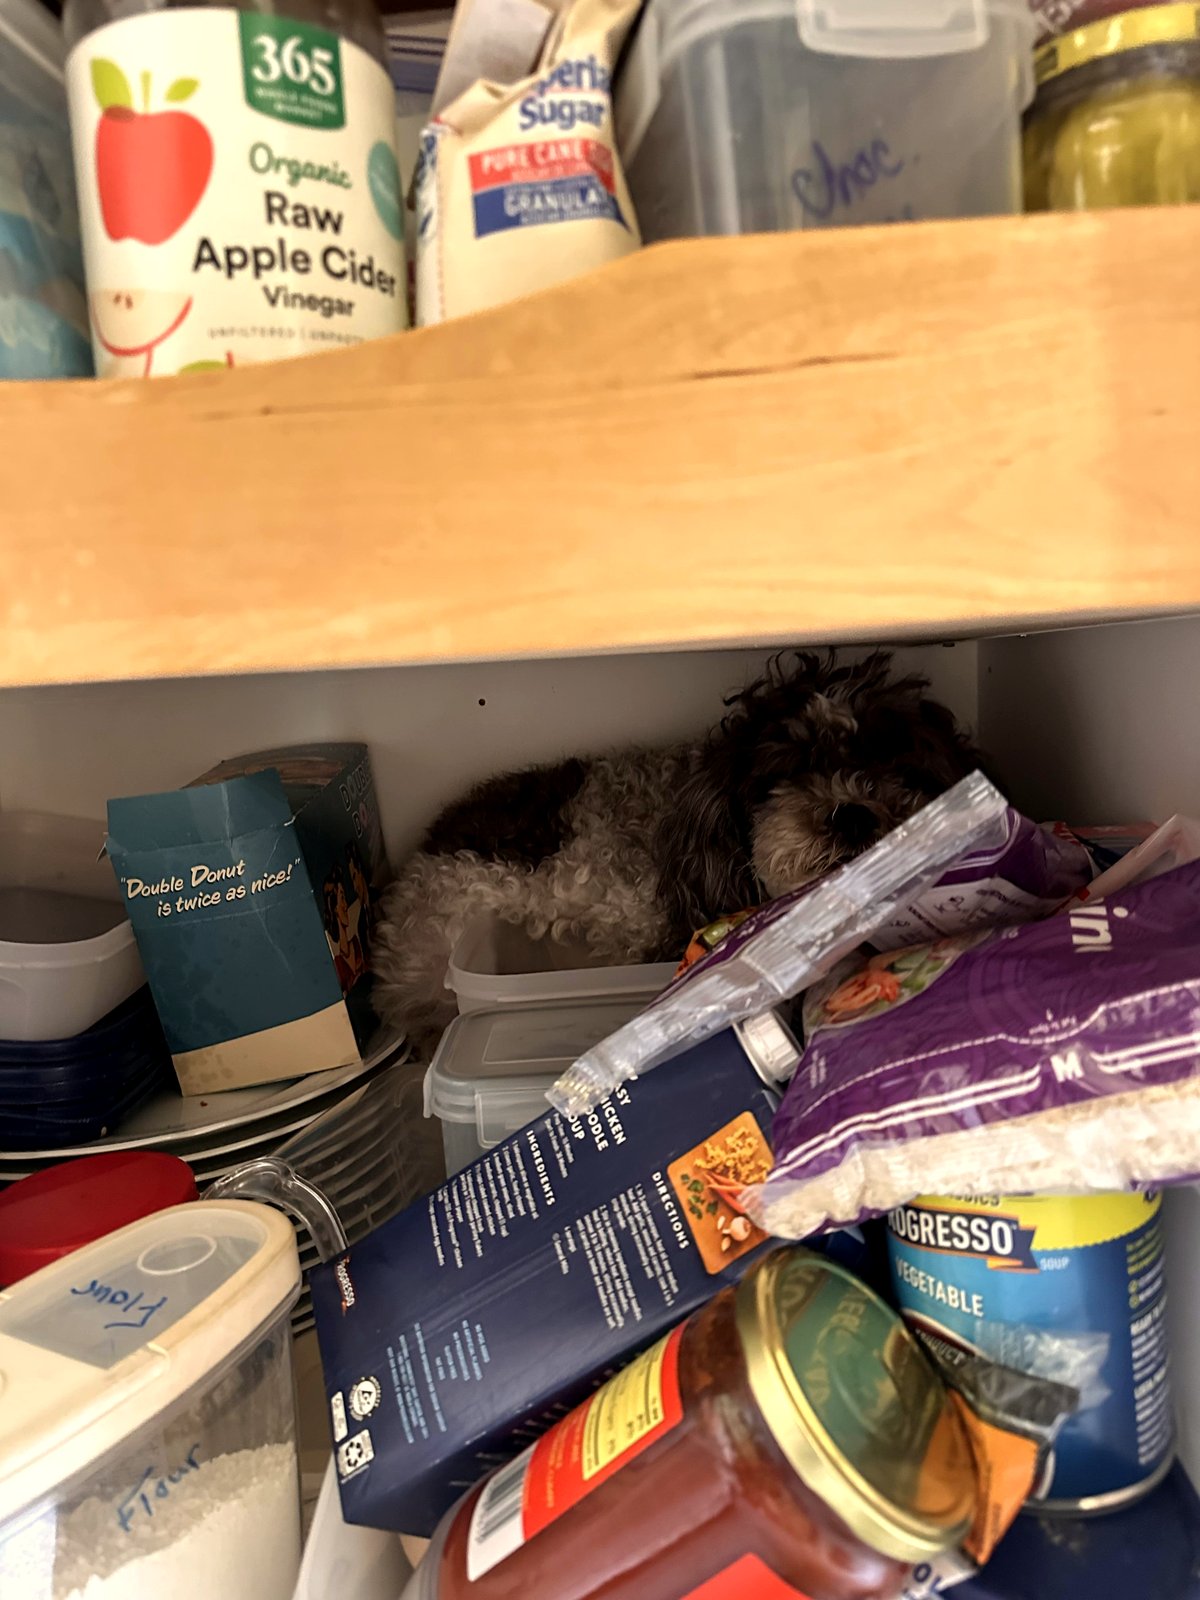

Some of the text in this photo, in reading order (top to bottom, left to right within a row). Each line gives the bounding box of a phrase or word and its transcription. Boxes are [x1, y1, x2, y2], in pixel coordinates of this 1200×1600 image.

[251, 35, 336, 96] 365
[520, 97, 604, 131] Sugar
[249, 142, 352, 191] Organic
[481, 149, 528, 175] PURE
[533, 140, 583, 165] CANE
[264, 191, 343, 236] Raw
[503, 186, 604, 217] GRANULA
[193, 238, 397, 297] Apple Cider
[263, 284, 355, 319] Vinegar
[121, 859, 247, 902] "Double Donut
[157, 856, 302, 919] is twice as nice!"
[567, 1113, 585, 1139] OUP
[526, 1130, 555, 1205] INGREDIENTS
[652, 1171, 690, 1250] DIRECTIONS
[888, 1206, 1013, 1255] ROGRESSO
[895, 1256, 984, 1318] VEGETABLE
[1040, 1256, 1070, 1271] SOUP
[70, 1279, 168, 1330] Flour
[117, 1443, 200, 1533] Flour
